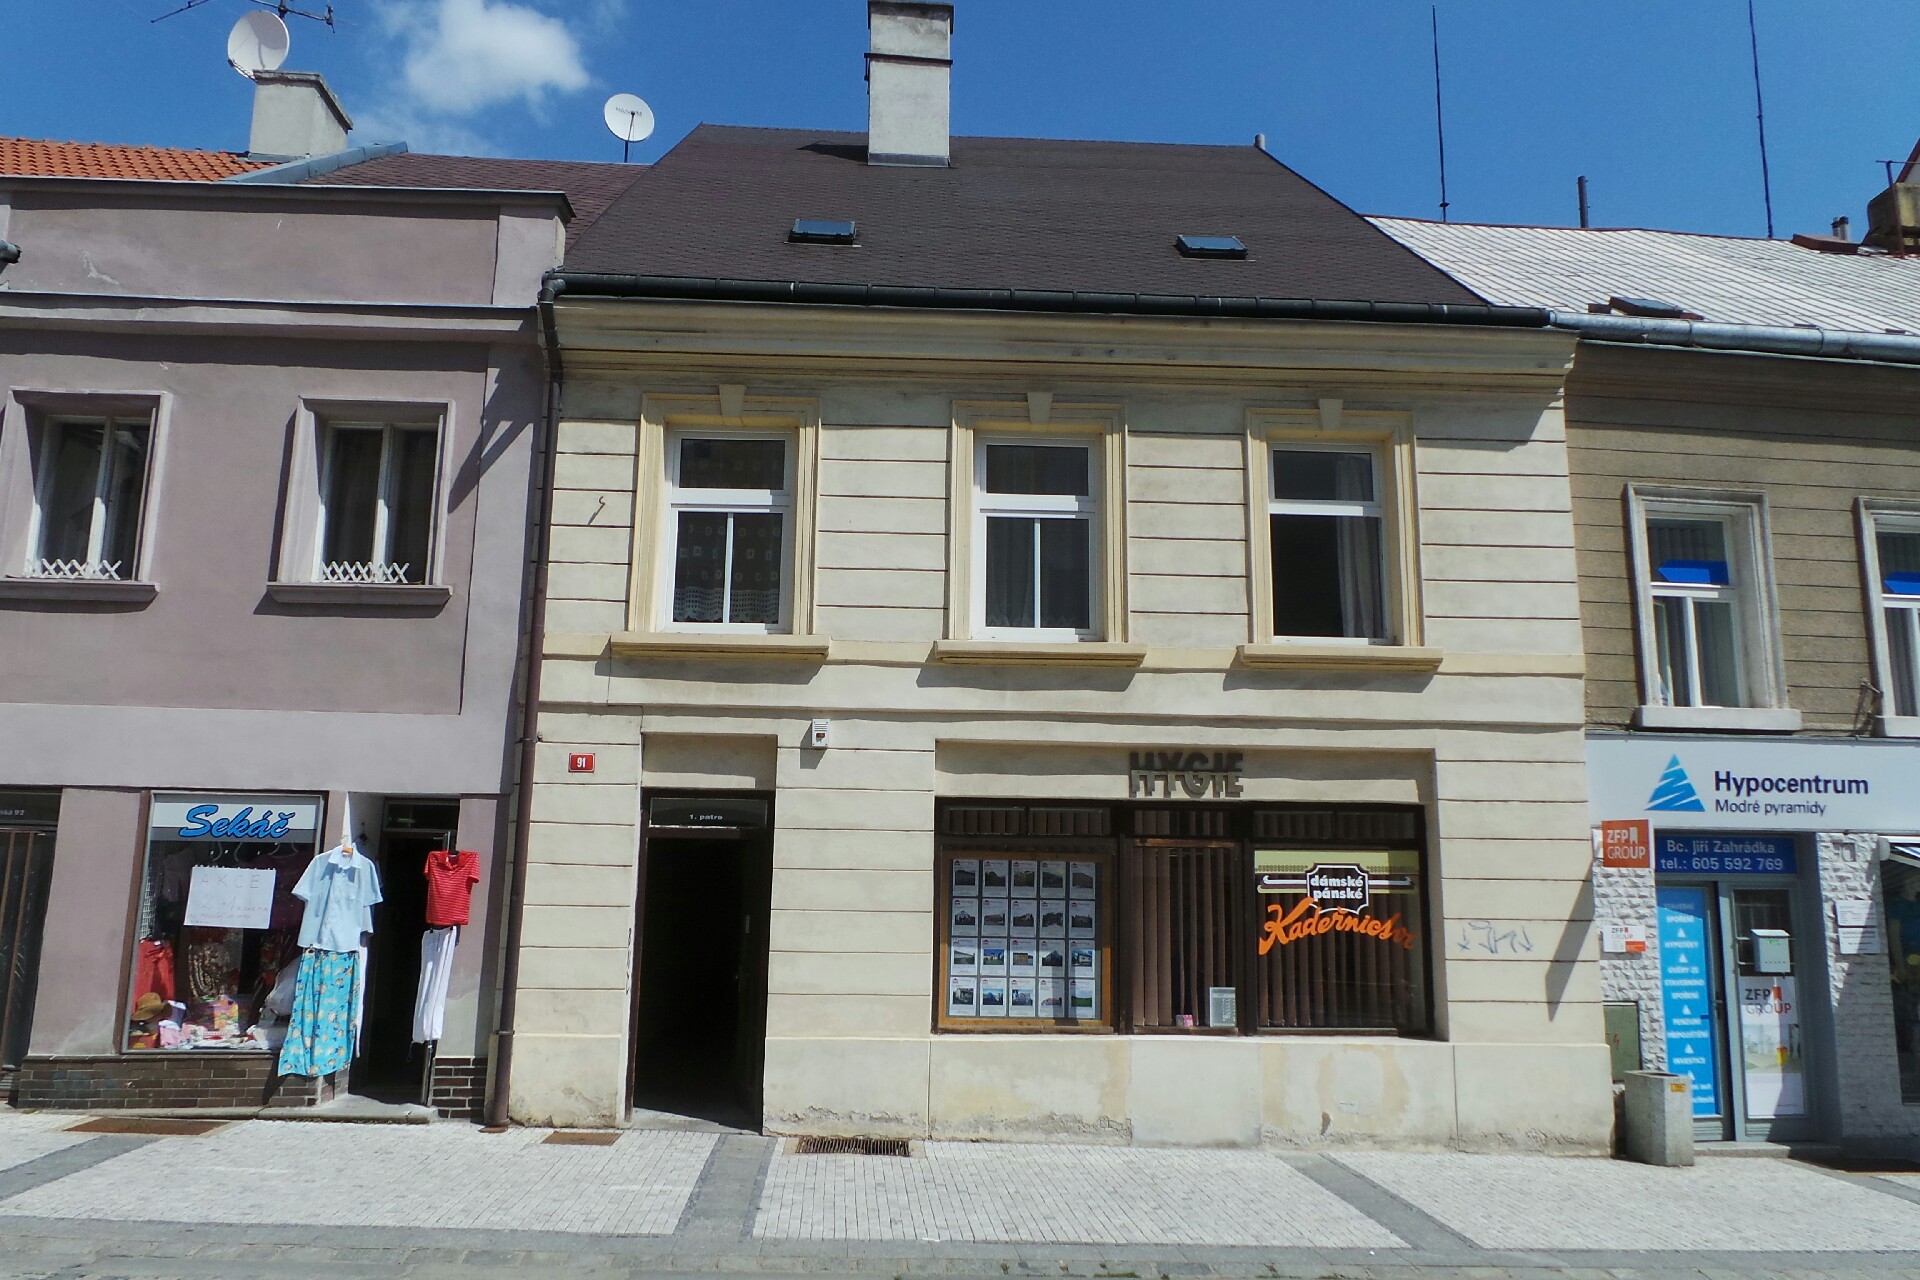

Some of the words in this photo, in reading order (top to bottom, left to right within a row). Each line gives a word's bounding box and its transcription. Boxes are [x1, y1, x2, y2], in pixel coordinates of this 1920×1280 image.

[577, 757, 586, 768] 91
[1714, 771, 1869, 797] Hypocentrum
[1715, 799, 1760, 813] Modré
[1764, 801, 1826, 816] pyramidy
[178, 804, 296, 839] Sekáč
[1607, 830, 1628, 844] ZFP
[1607, 846, 1646, 859] GROUP
[1666, 840, 1688, 853] Bc.
[1692, 841, 1709, 855] Jiří
[1713, 840, 1776, 854] Zahrádka
[1660, 858, 1688, 870] tel.:
[1692, 858, 1719, 870] 605
[1724, 858, 1752, 870] 592
[1756, 858, 1783, 871] 769
[1310, 875, 1364, 887] dámské
[1313, 888, 1363, 901] pánské
[1745, 988, 1771, 1001] ZFP
[1746, 1002, 1792, 1015] GROUP
